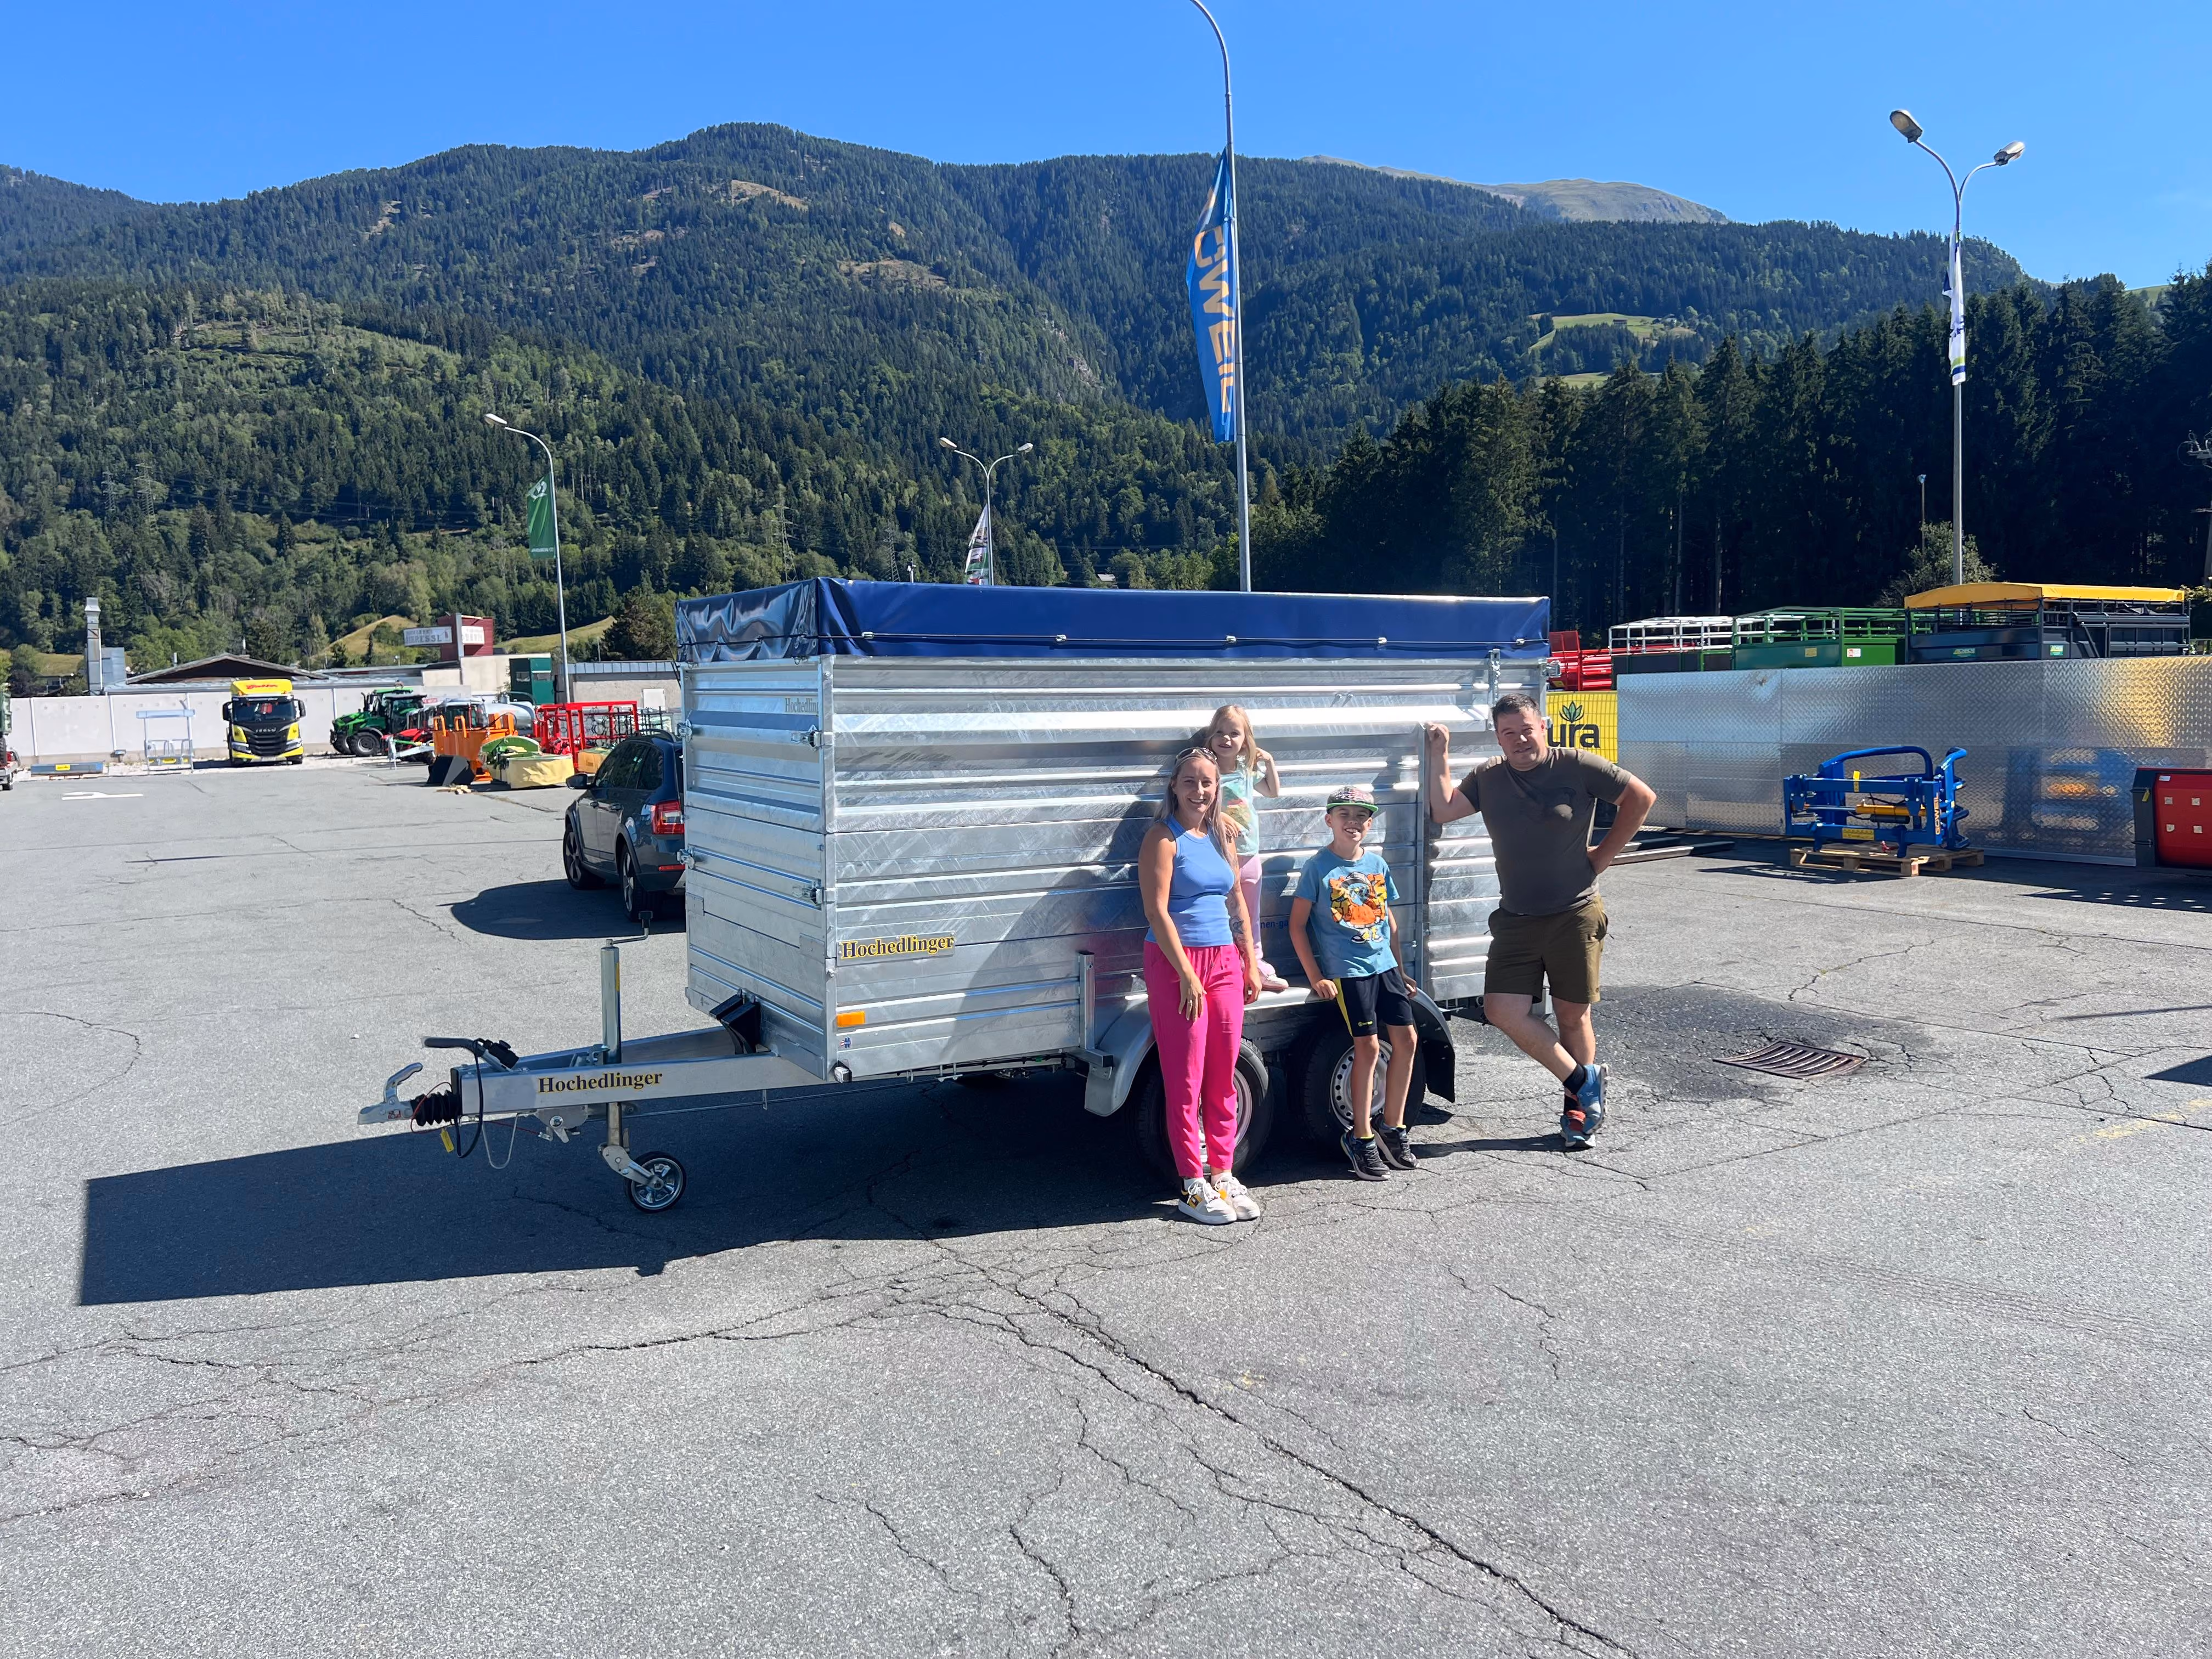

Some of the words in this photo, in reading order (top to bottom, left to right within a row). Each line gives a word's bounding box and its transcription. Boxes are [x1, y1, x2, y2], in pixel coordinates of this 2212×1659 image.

[1547, 724, 1600, 748] ura
[841, 935, 955, 959] Hochedlinger
[538, 1072, 663, 1093] Hochedlinger
